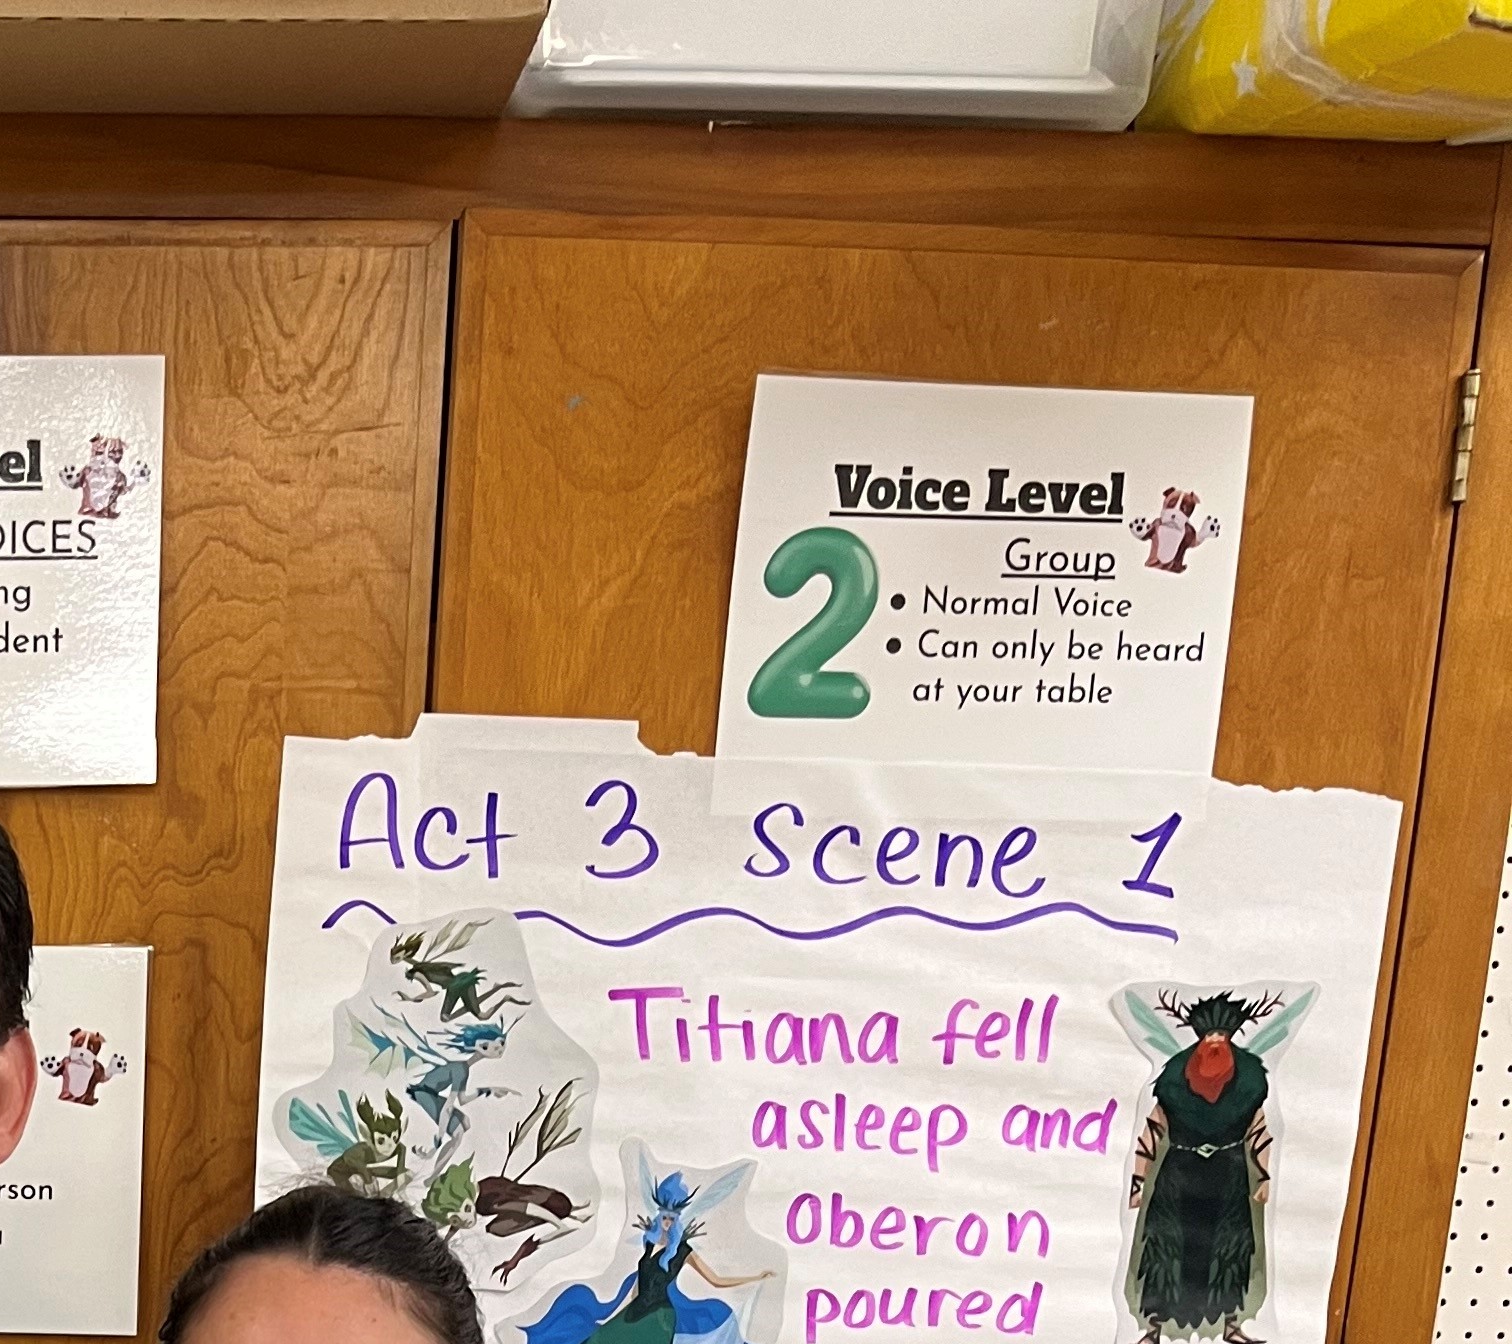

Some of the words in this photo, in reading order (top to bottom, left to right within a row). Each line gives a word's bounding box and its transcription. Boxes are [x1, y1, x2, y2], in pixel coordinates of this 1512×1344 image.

[835, 464, 970, 513] Voice
[985, 468, 1125, 517] Level
[1003, 537, 1116, 582] Group
[746, 526, 880, 720] 2
[923, 585, 1038, 617] Normal
[1053, 586, 1133, 619] Voice
[918, 629, 978, 660] Can
[992, 631, 1056, 667] only
[1067, 630, 1101, 662] be
[1116, 632, 1206, 664] heard
[912, 676, 945, 703] at
[956, 679, 1022, 710] your
[1036, 675, 1113, 705] table
[338, 770, 515, 878] Act
[585, 779, 661, 880] 3
[1130, 811, 1185, 899] 1
[608, 988, 899, 1064] Titiana
[935, 993, 1061, 1064] fell
[753, 1094, 967, 1177] asleep
[1003, 1096, 1117, 1154] and
[786, 1191, 1050, 1258] Oberon
